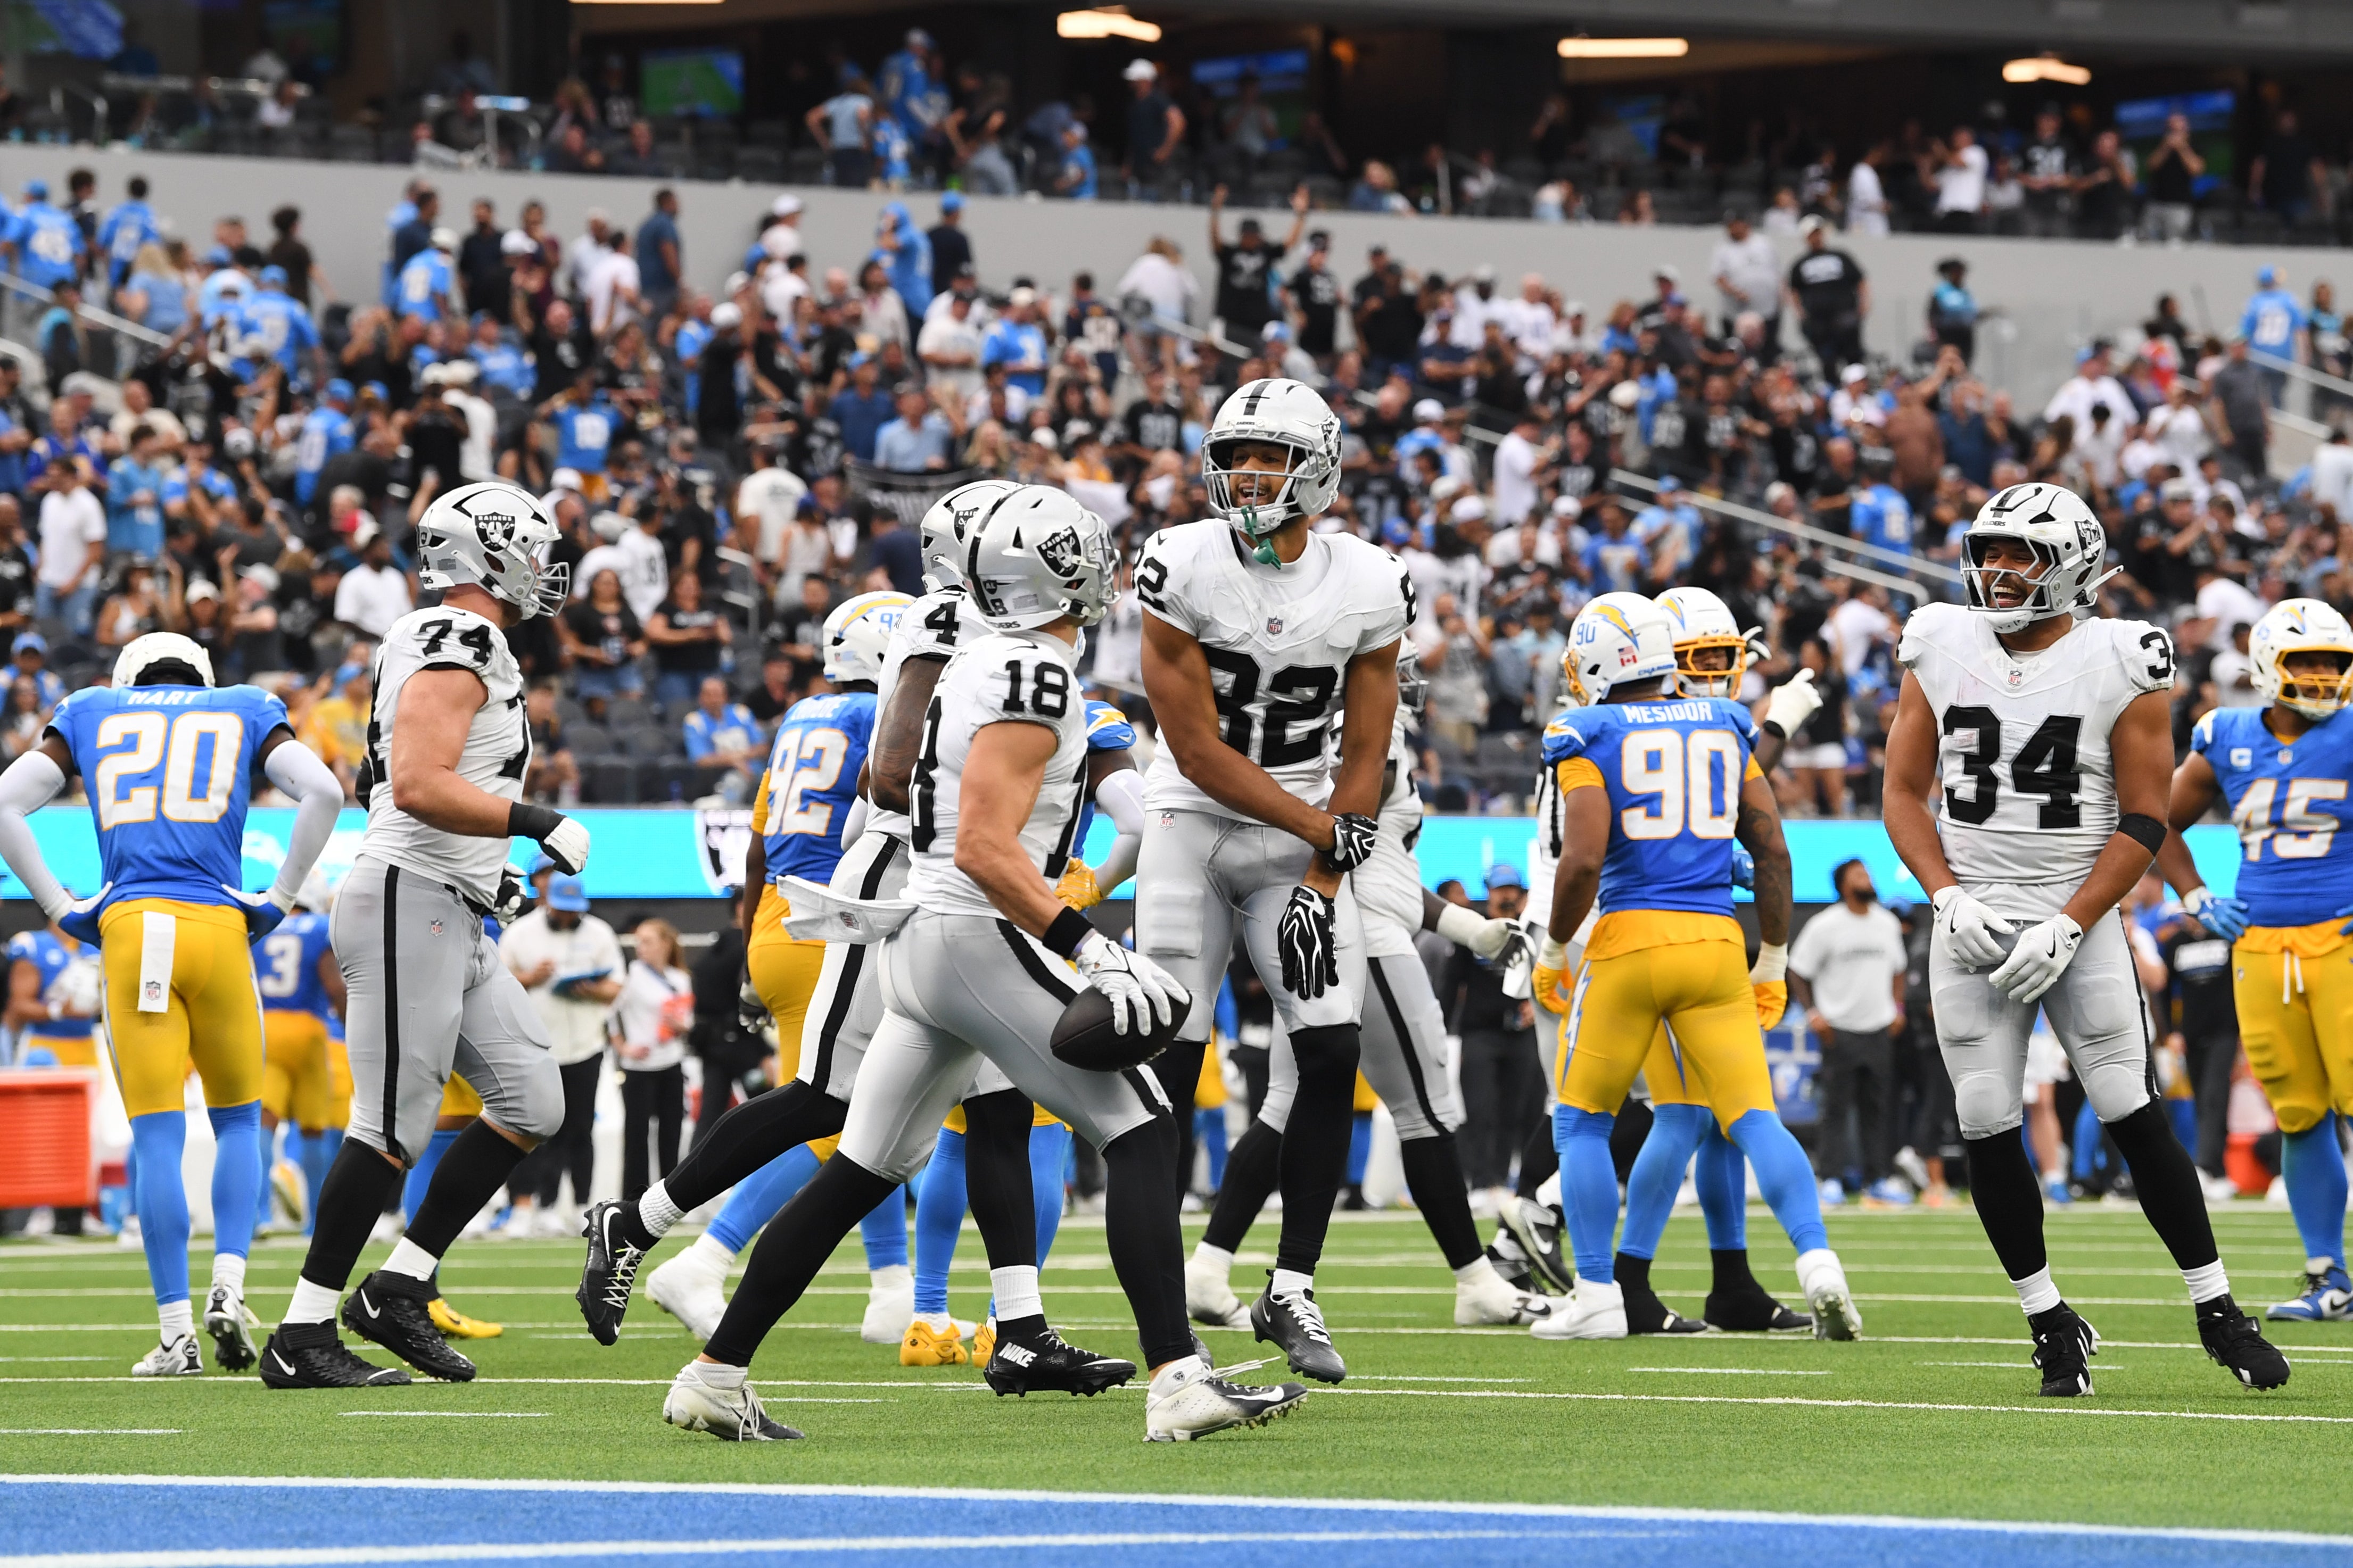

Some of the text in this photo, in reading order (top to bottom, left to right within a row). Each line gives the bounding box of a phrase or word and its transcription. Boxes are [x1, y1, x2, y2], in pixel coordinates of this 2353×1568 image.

[418, 619, 492, 666] 74
[923, 602, 962, 647] 4
[1576, 621, 1597, 645] 90
[2139, 632, 2176, 679] 3
[127, 690, 200, 706] HART
[1003, 659, 1069, 719] 18
[1622, 701, 1713, 724] MESIDOR
[96, 711, 244, 831] 20
[764, 728, 849, 837] 92
[1621, 728, 1741, 840] 90
[1941, 703, 2085, 830] 34
[2231, 778, 2349, 861] 45
[260, 934, 303, 998] 3
[998, 1342, 1038, 1368] NIKE
